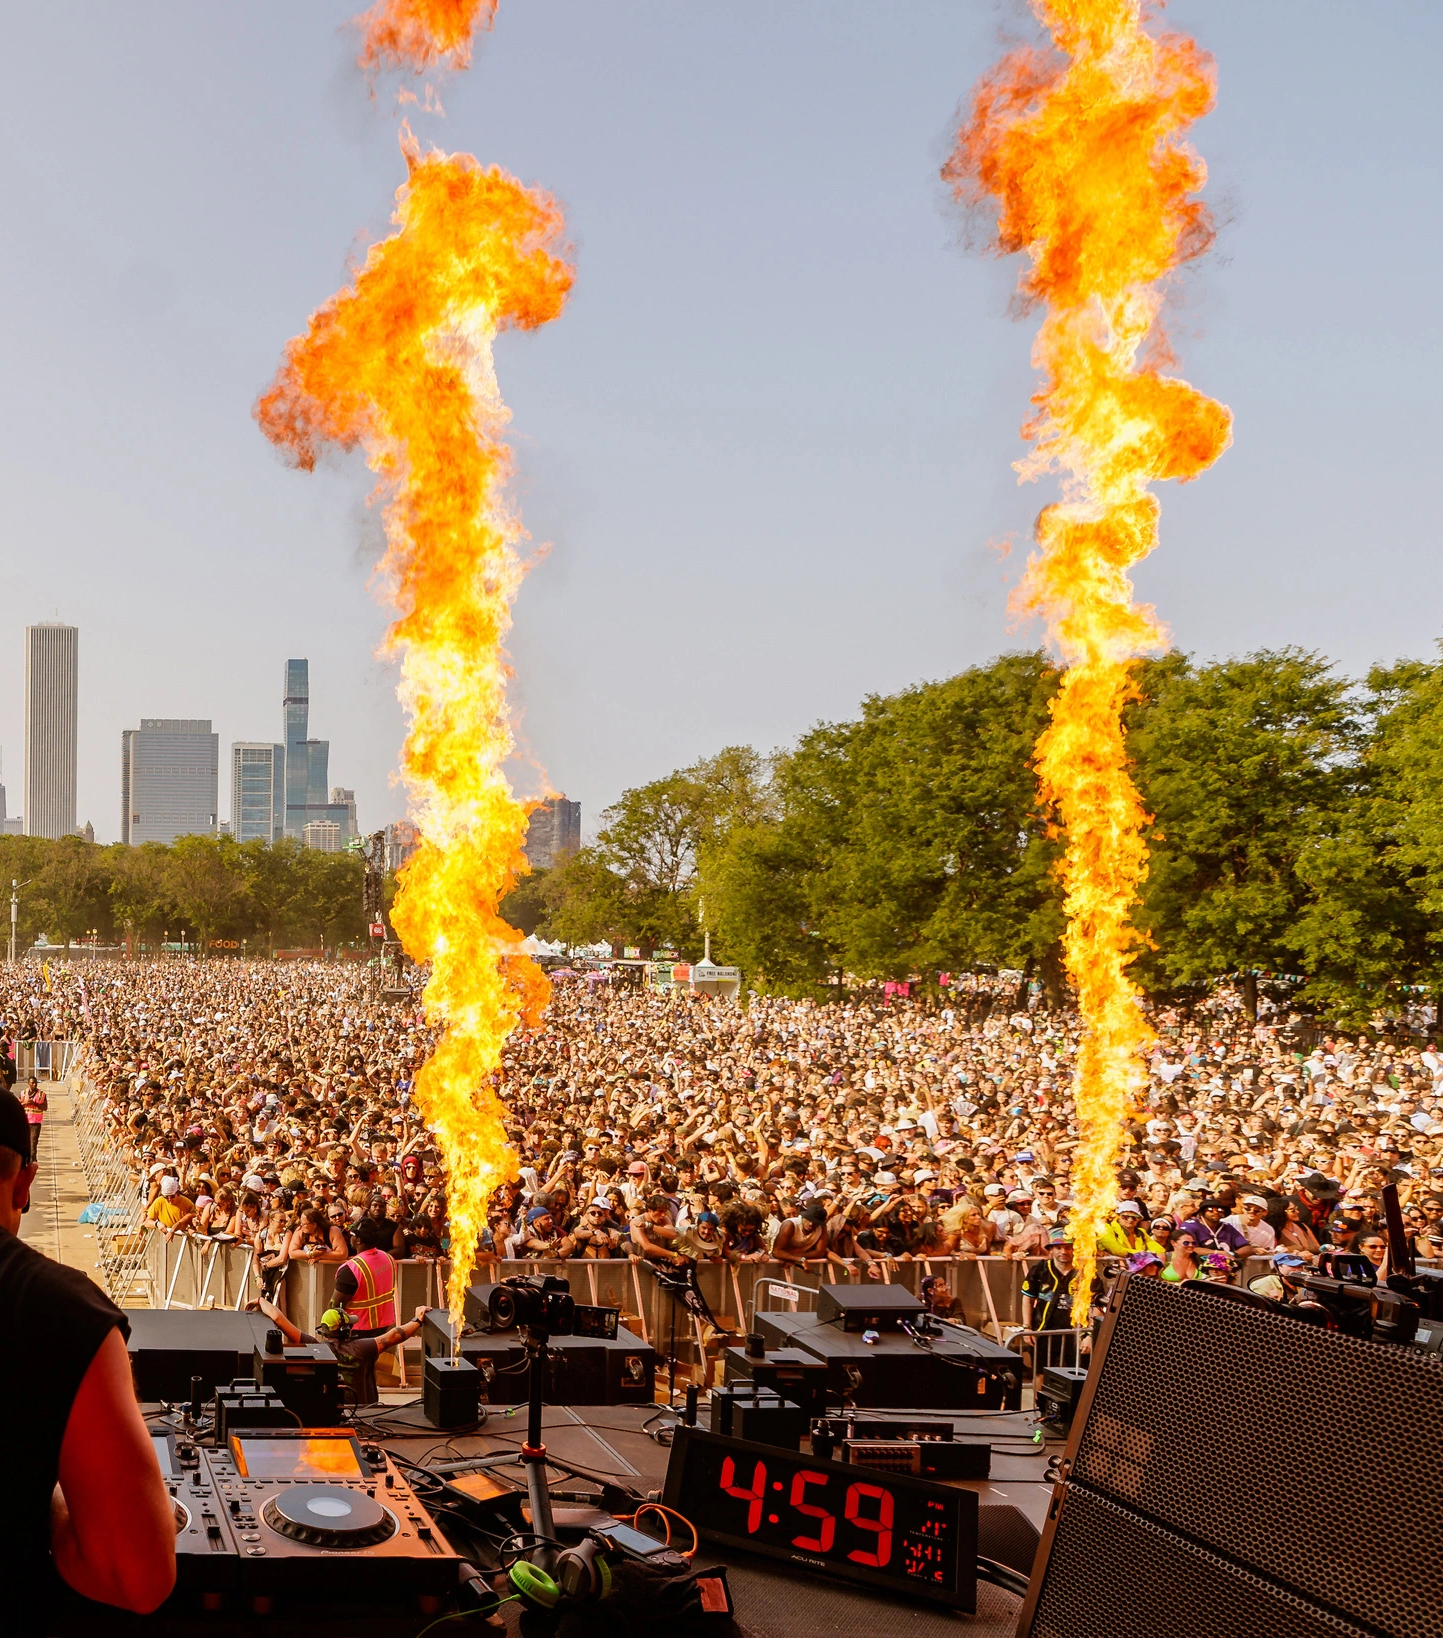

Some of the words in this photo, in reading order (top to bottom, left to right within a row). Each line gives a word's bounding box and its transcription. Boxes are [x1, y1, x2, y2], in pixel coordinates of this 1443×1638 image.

[209, 940, 239, 949] FOOD
[928, 1501, 944, 1511] PM
[720, 1456, 894, 1568] 4:59
